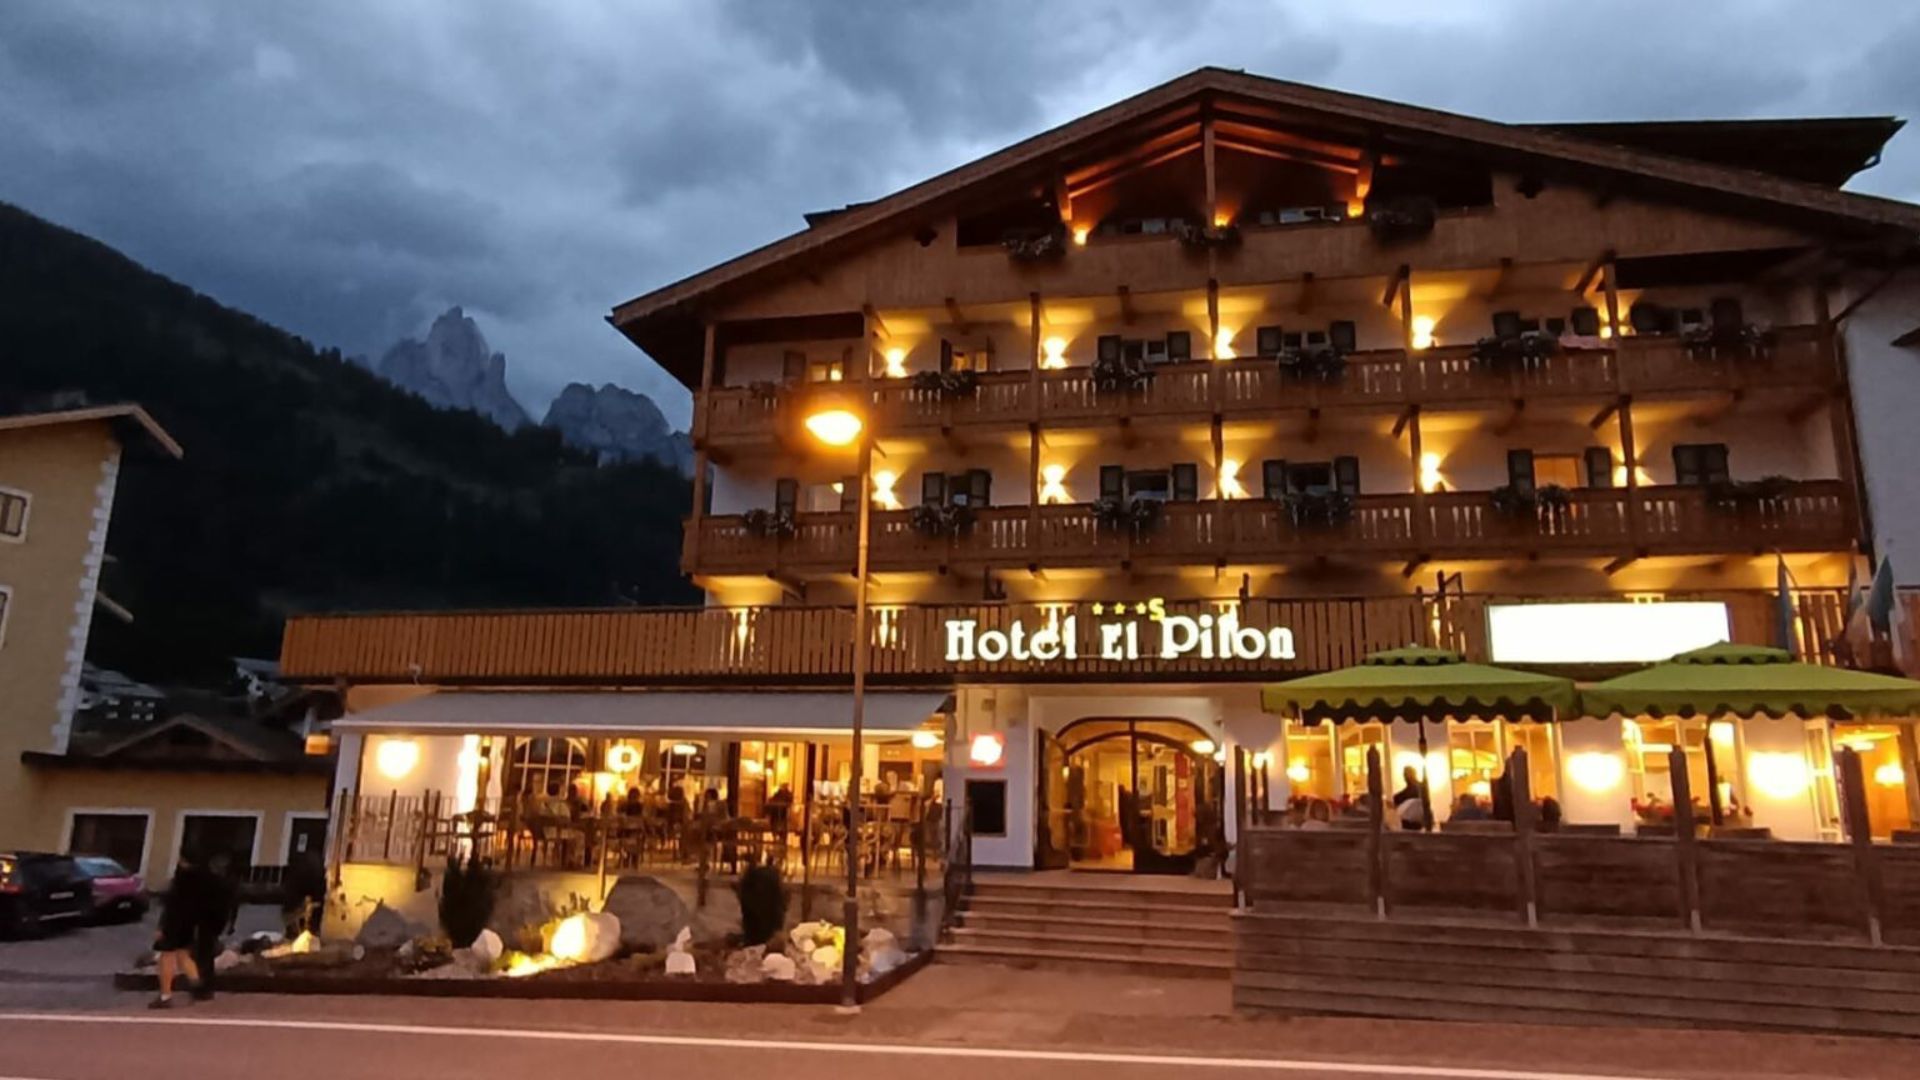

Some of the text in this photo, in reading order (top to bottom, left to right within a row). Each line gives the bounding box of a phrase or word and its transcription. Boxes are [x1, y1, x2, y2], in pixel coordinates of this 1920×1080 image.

[944, 611, 1296, 661] Hotel El Pilon
